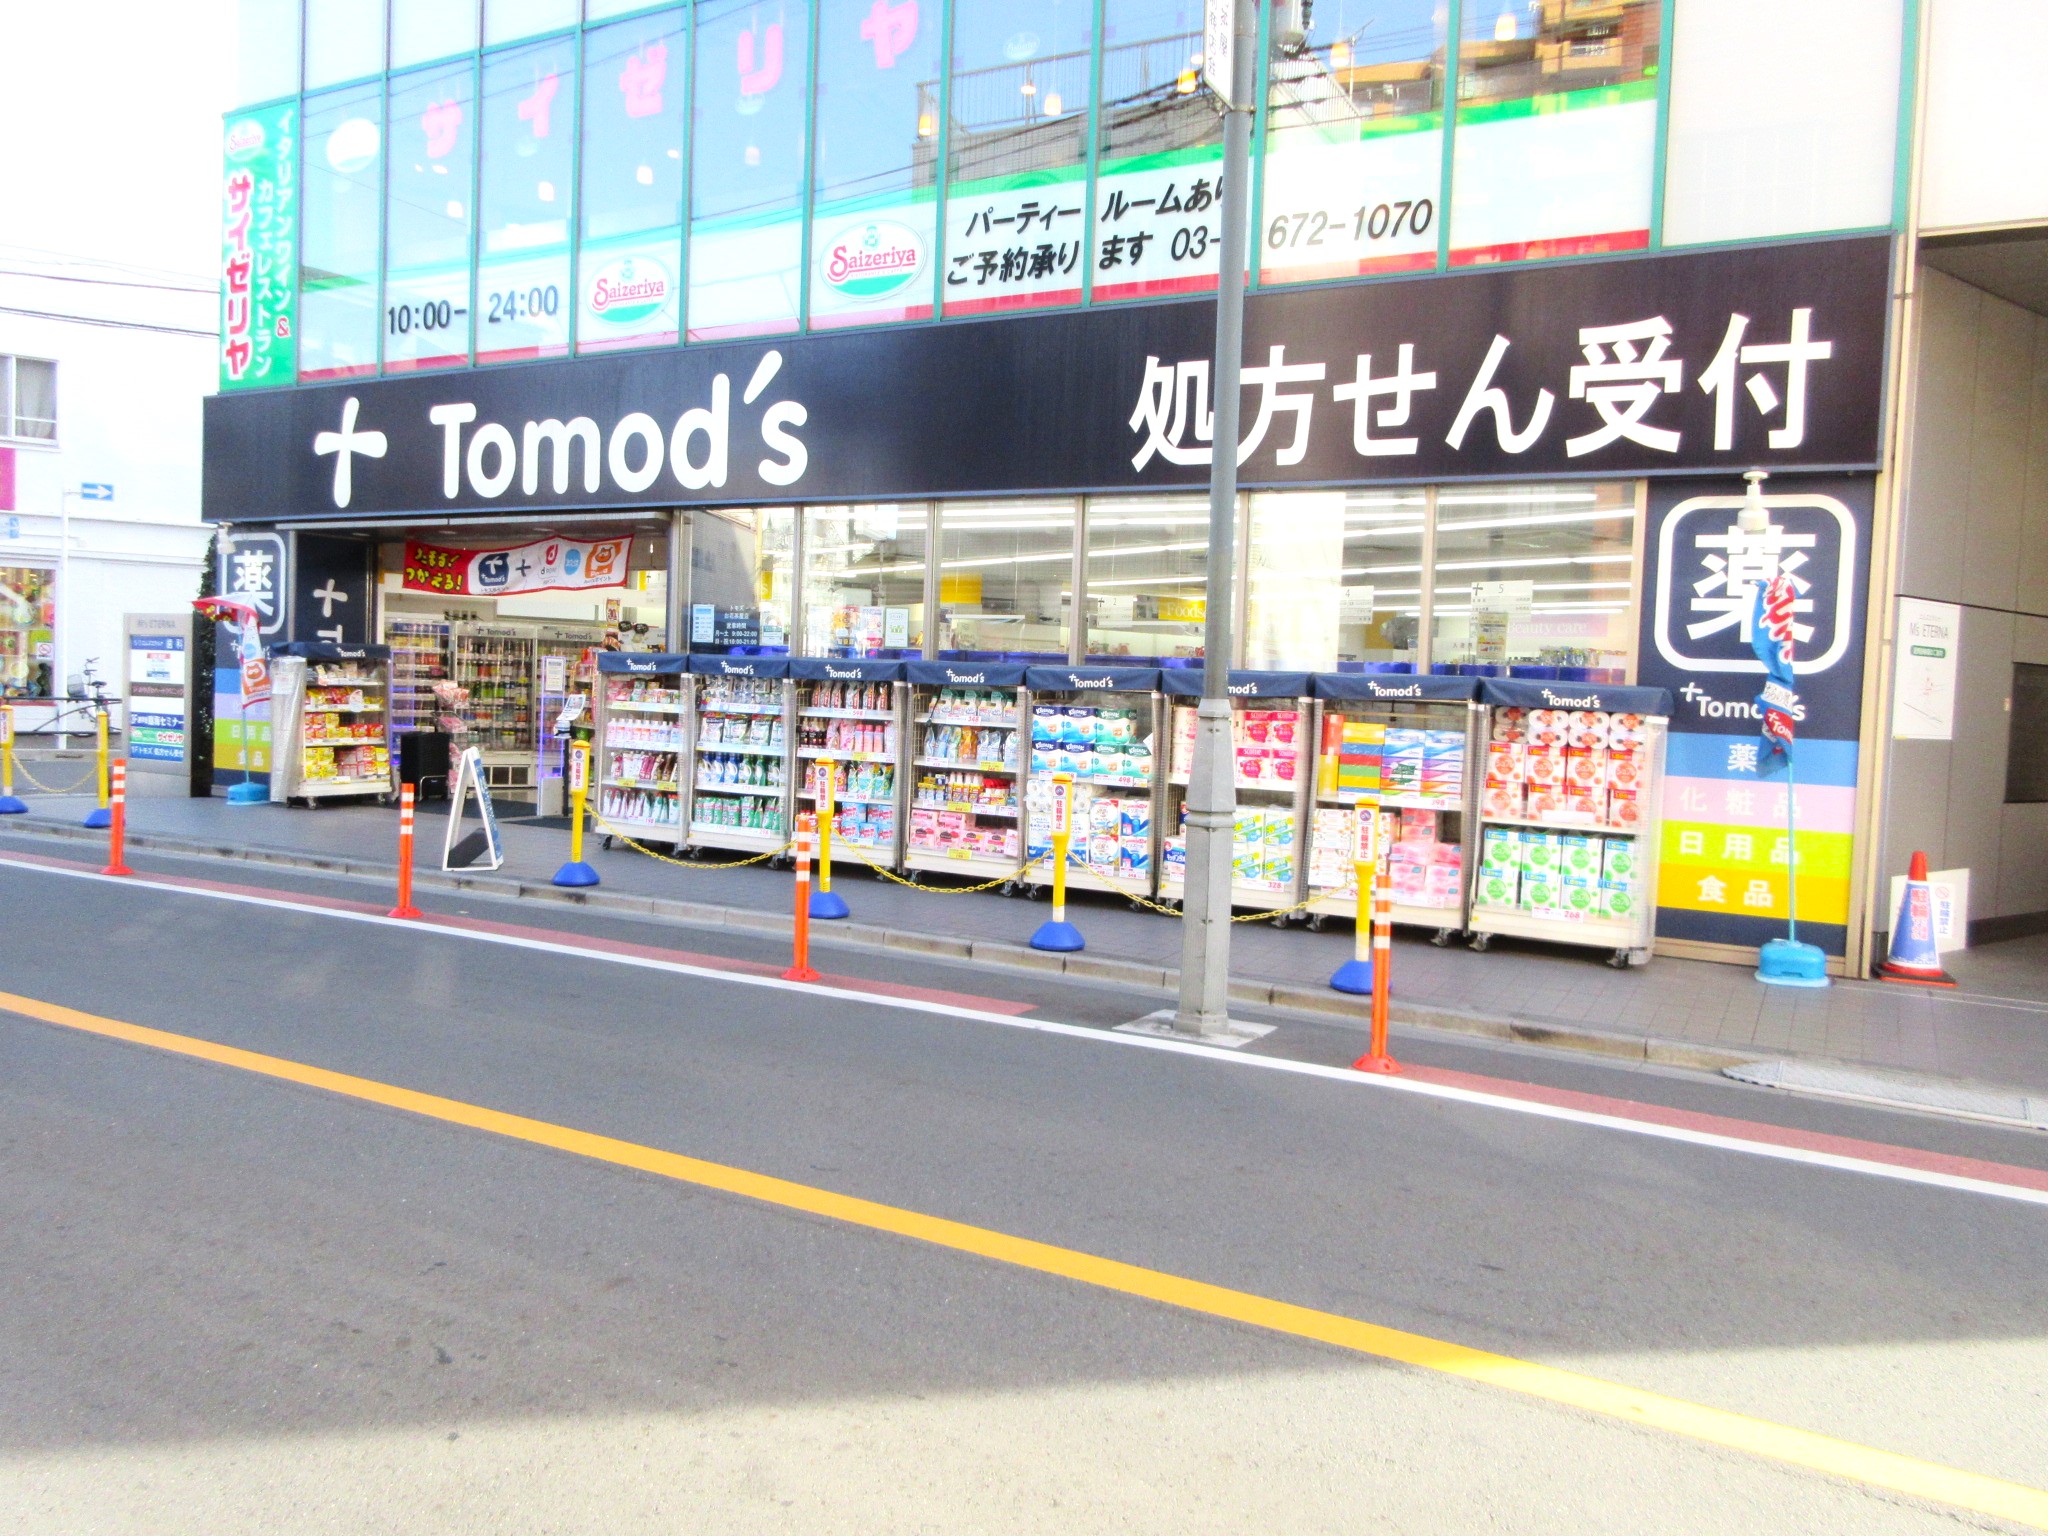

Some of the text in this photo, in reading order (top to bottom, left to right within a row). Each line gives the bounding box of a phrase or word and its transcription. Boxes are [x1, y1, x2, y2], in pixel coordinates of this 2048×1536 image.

[226, 174, 252, 376] サイゼリヤ
[827, 245, 916, 282] Saizeriya
[947, 240, 1080, 285] ご予約承り
[489, 285, 559, 324] 24:00
[592, 278, 665, 311] Saizeriya
[1130, 308, 1832, 473] 処方せん受付
[429, 350, 808, 500] Tomod's
[1690, 523, 1816, 643] 薬
[630, 661, 656, 671] Tomod's
[724, 664, 754, 675] Tomod's
[829, 667, 862, 679] Tomod's
[950, 672, 985, 683] Tomod's
[1074, 675, 1113, 688] Tomod's
[1374, 683, 1421, 697] Tomod's
[1548, 694, 1600, 708] Tomod's
[1728, 733, 1758, 773] 薬
[1679, 830, 1800, 866] 日用品
[1696, 874, 1774, 908] 食品
[1564, 910, 1581, 919] 268
